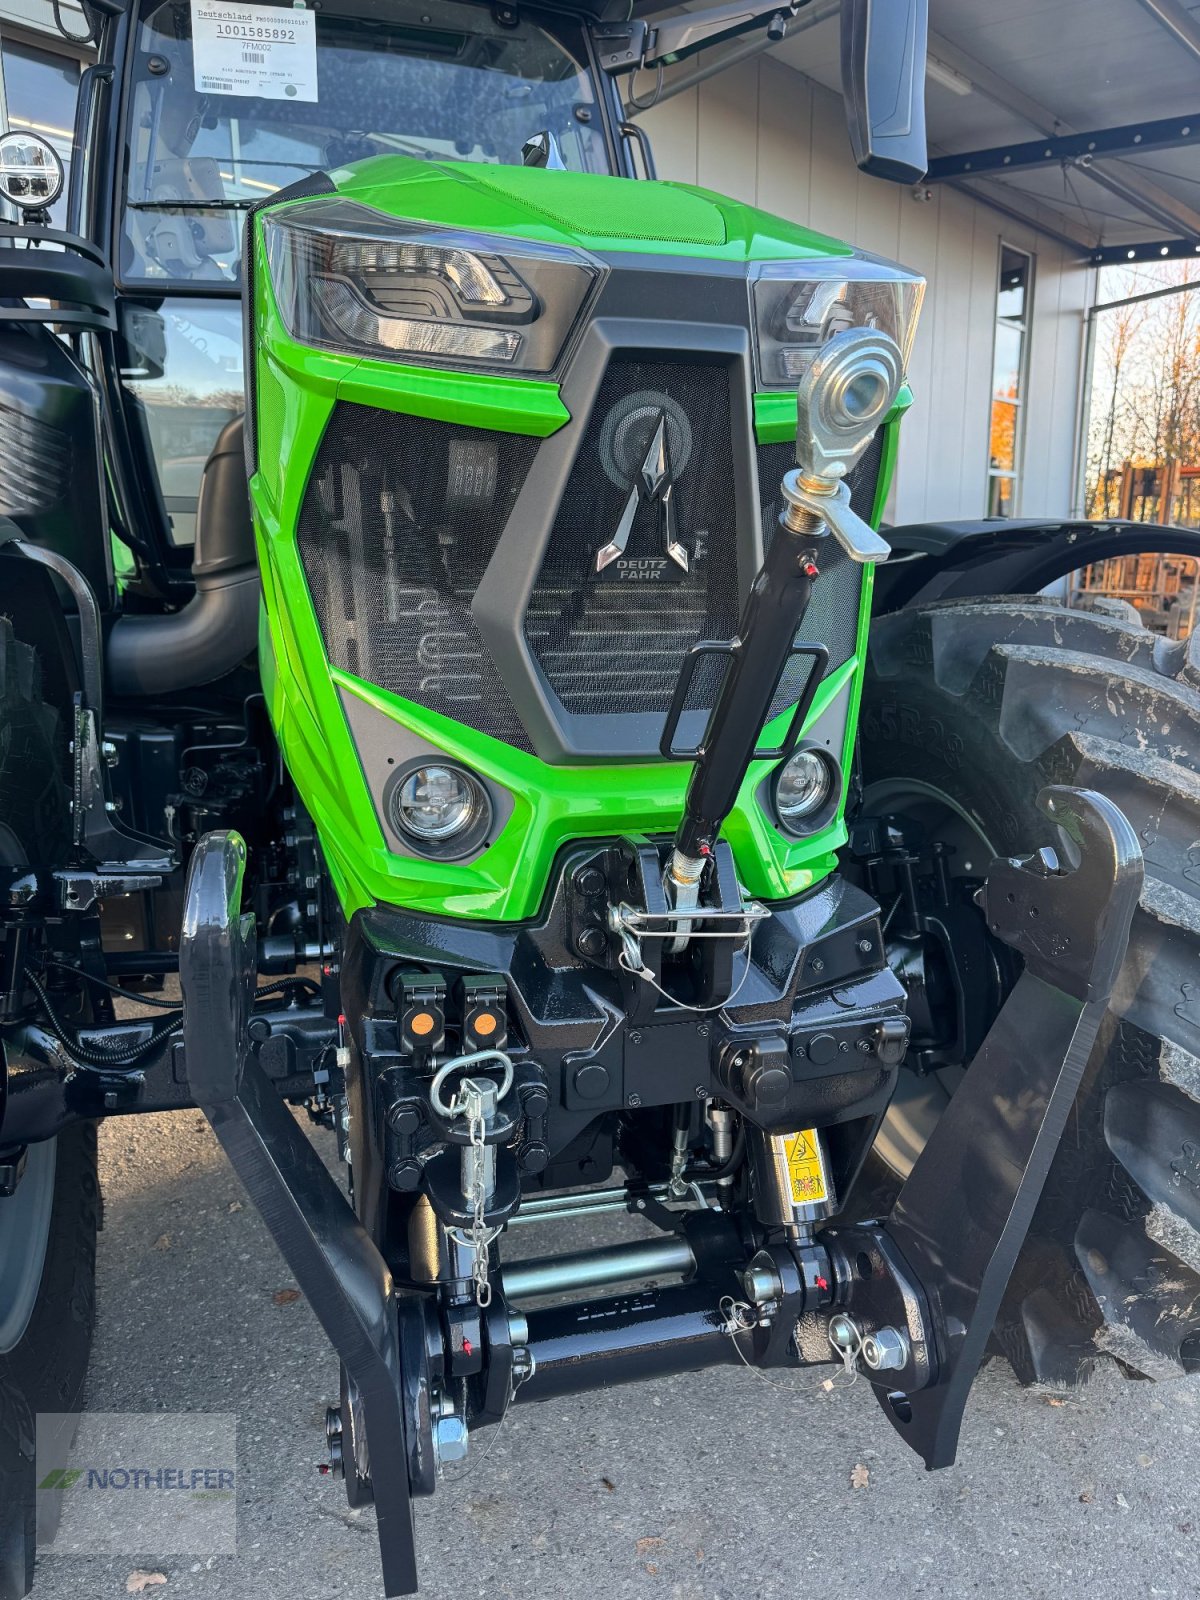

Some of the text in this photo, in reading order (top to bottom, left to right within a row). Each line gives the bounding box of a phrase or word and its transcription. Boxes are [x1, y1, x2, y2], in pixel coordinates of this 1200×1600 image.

[198, 9, 252, 21] Deutschland
[216, 24, 295, 40] 1001585892
[241, 41, 272, 52] 7FM002
[616, 560, 668, 569] DEUTZ
[620, 570, 661, 579] FAHR
